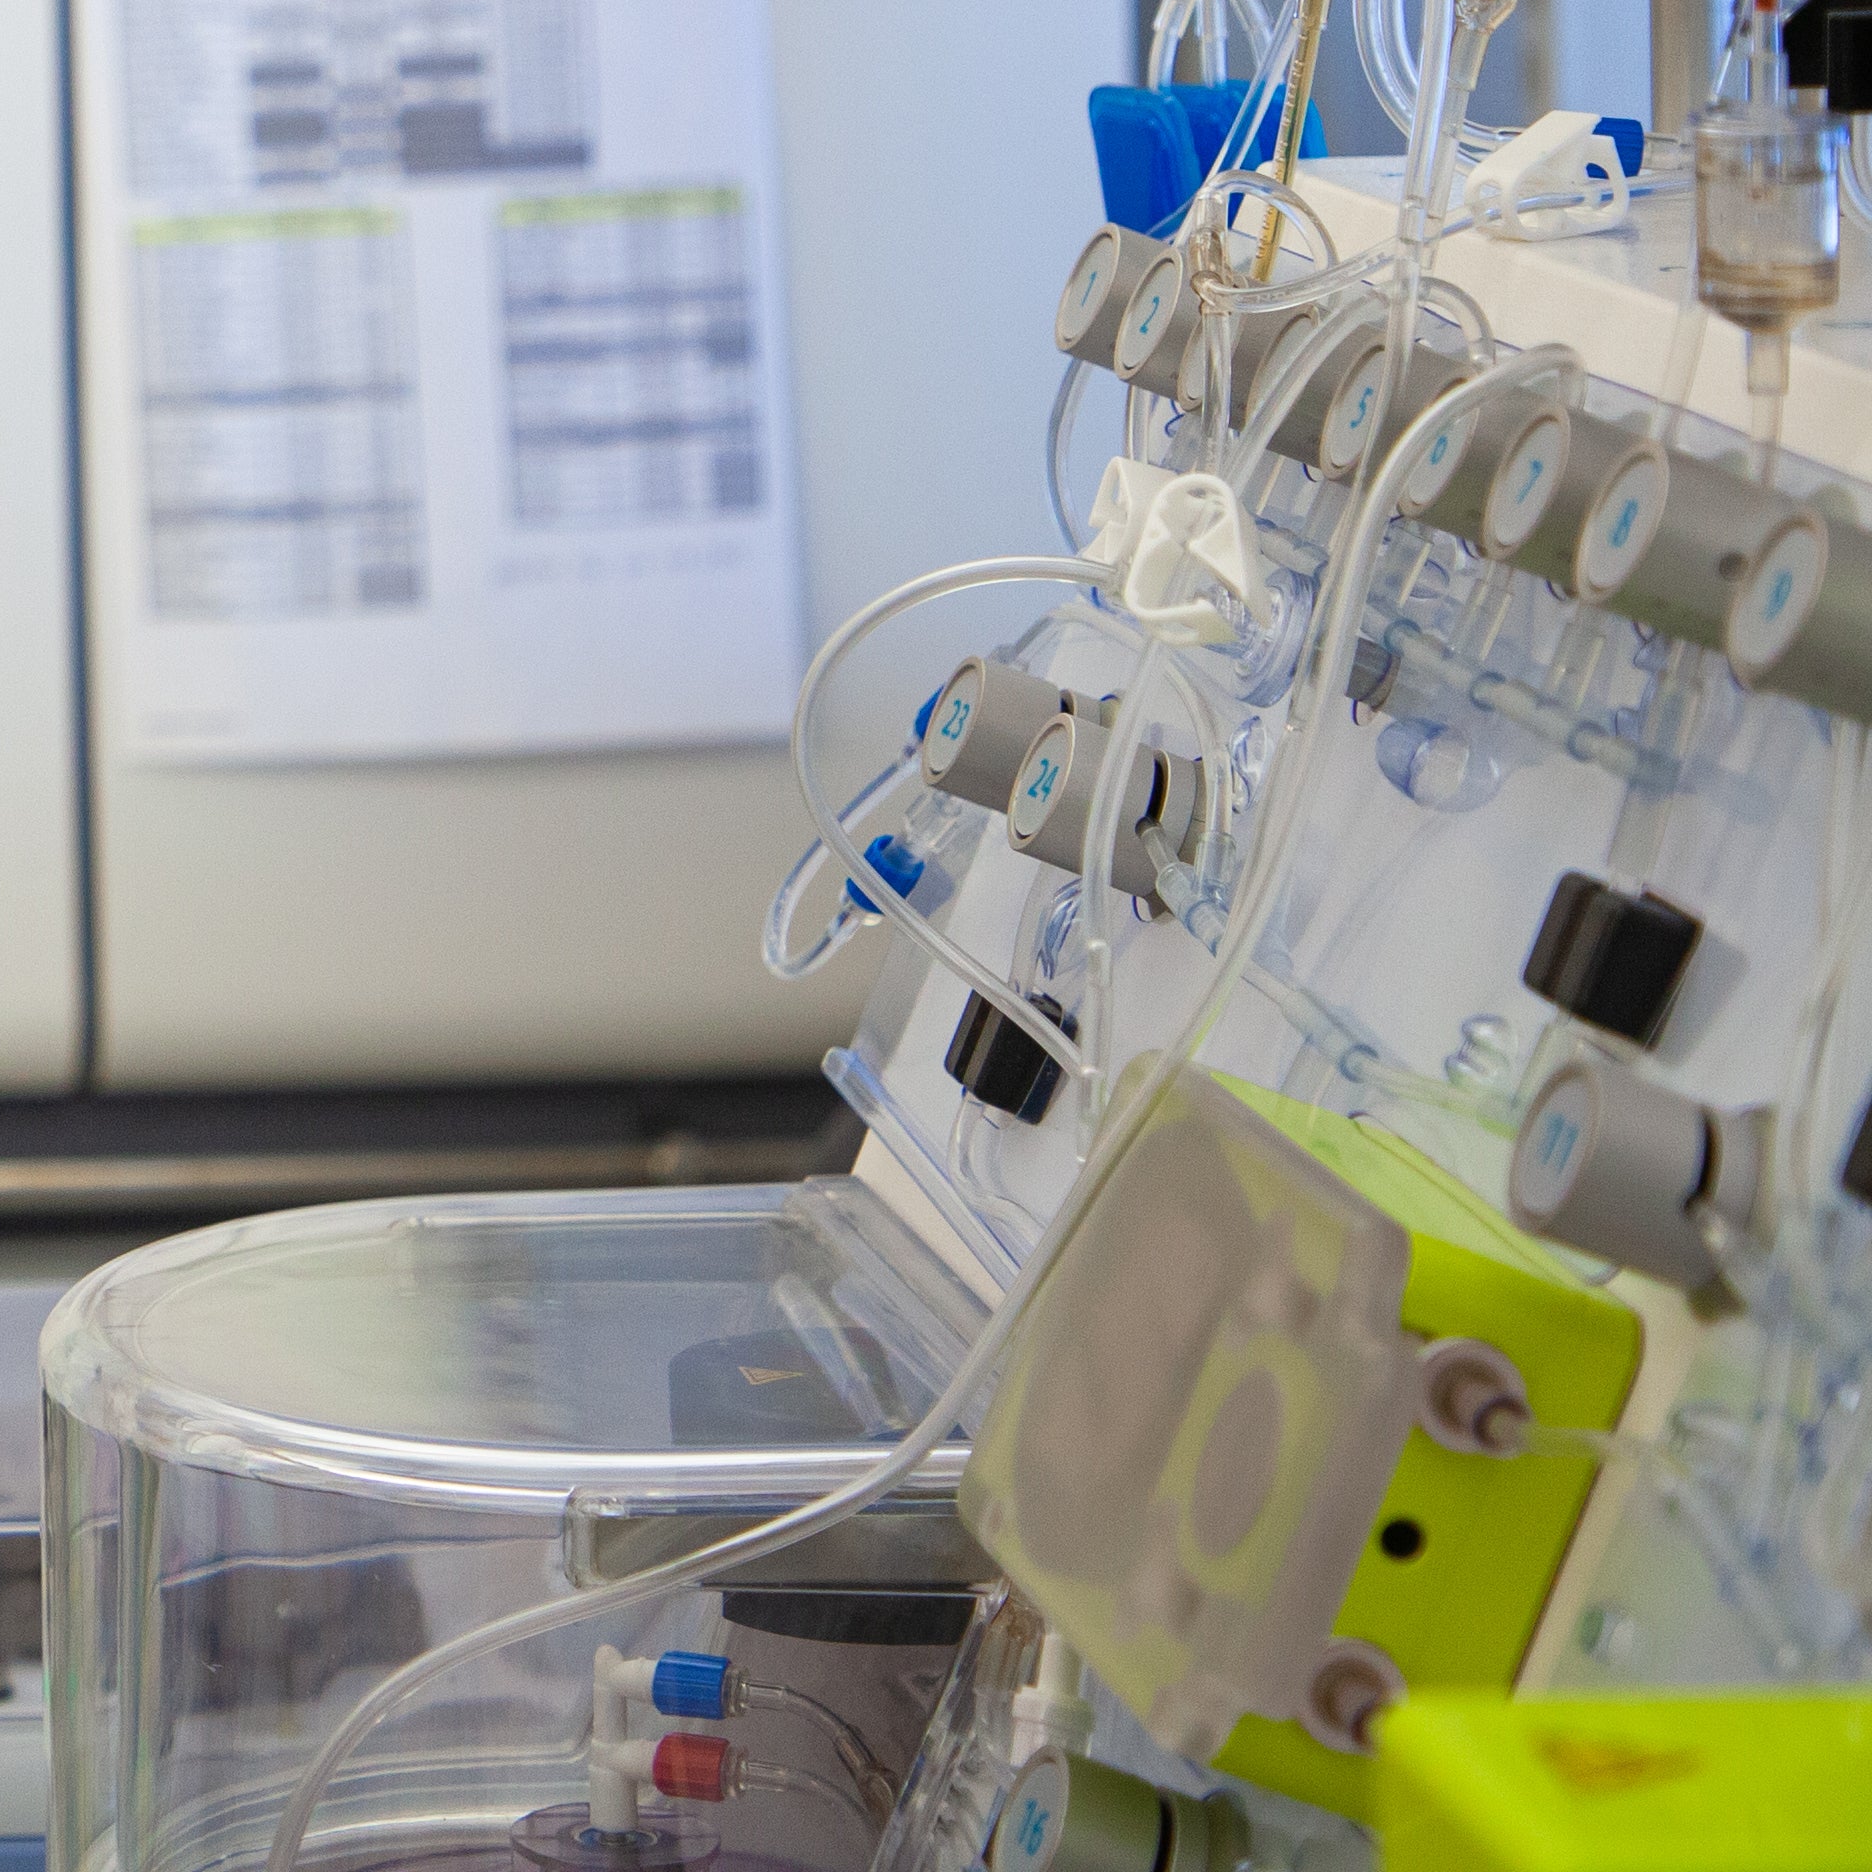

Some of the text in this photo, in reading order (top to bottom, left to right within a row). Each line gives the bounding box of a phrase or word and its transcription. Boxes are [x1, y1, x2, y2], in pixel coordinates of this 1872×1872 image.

[1080, 270, 1098, 309] 1
[1139, 295, 1161, 336] 2
[1349, 386, 1374, 430] 5
[1515, 458, 1544, 504] 7
[1608, 498, 1639, 548] 8
[941, 697, 971, 741] 23
[1027, 757, 1060, 803] 24
[1537, 1112, 1581, 1174] 11
[1017, 1797, 1051, 1857] 16
